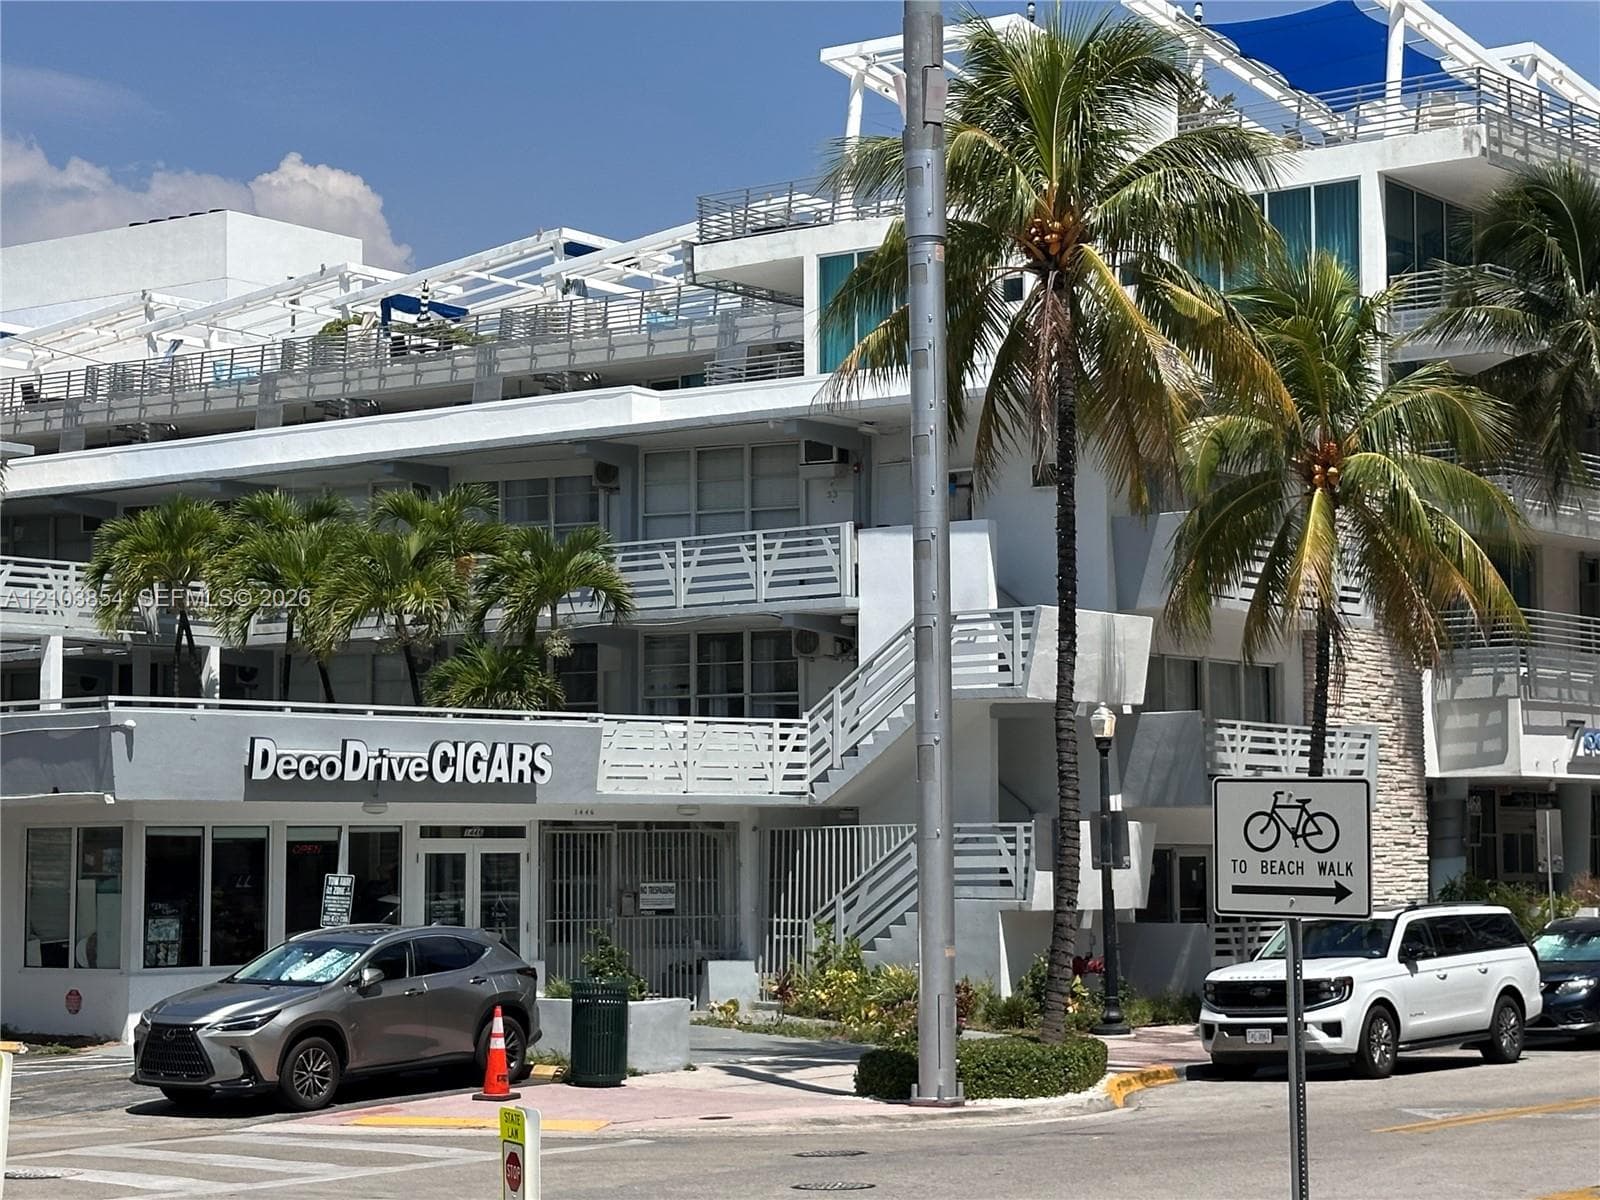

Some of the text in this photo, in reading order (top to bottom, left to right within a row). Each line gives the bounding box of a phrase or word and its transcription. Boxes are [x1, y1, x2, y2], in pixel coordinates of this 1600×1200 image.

[1231, 859, 1353, 877] TO BEACH WALK
[504, 1112, 520, 1126] STATE
[508, 1128, 519, 1139] LAW
[507, 1163, 520, 1179] STOP
